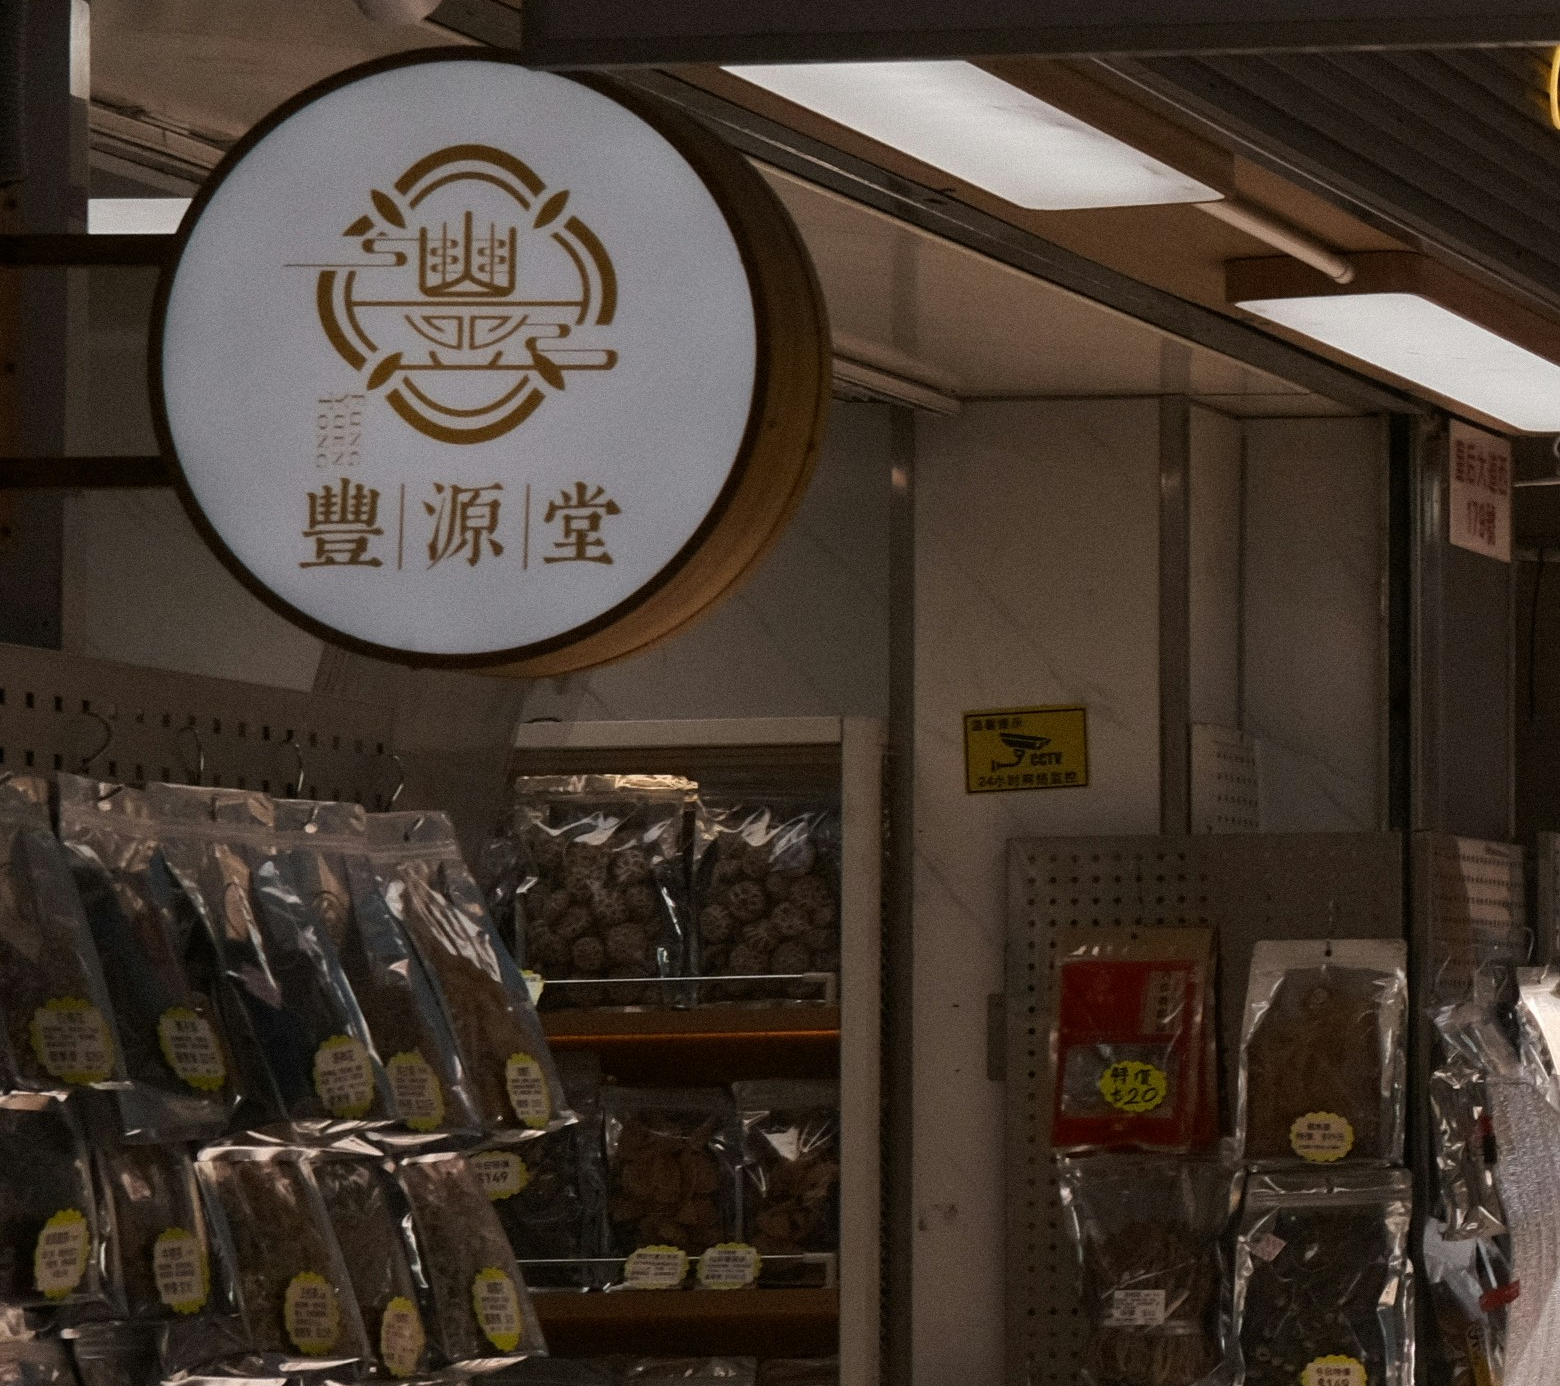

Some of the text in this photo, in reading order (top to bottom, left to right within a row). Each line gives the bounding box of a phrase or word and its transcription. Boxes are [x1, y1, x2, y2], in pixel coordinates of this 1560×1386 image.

[298, 477, 622, 570] 豐源堂
[1110, 1088, 1159, 1105] $20
